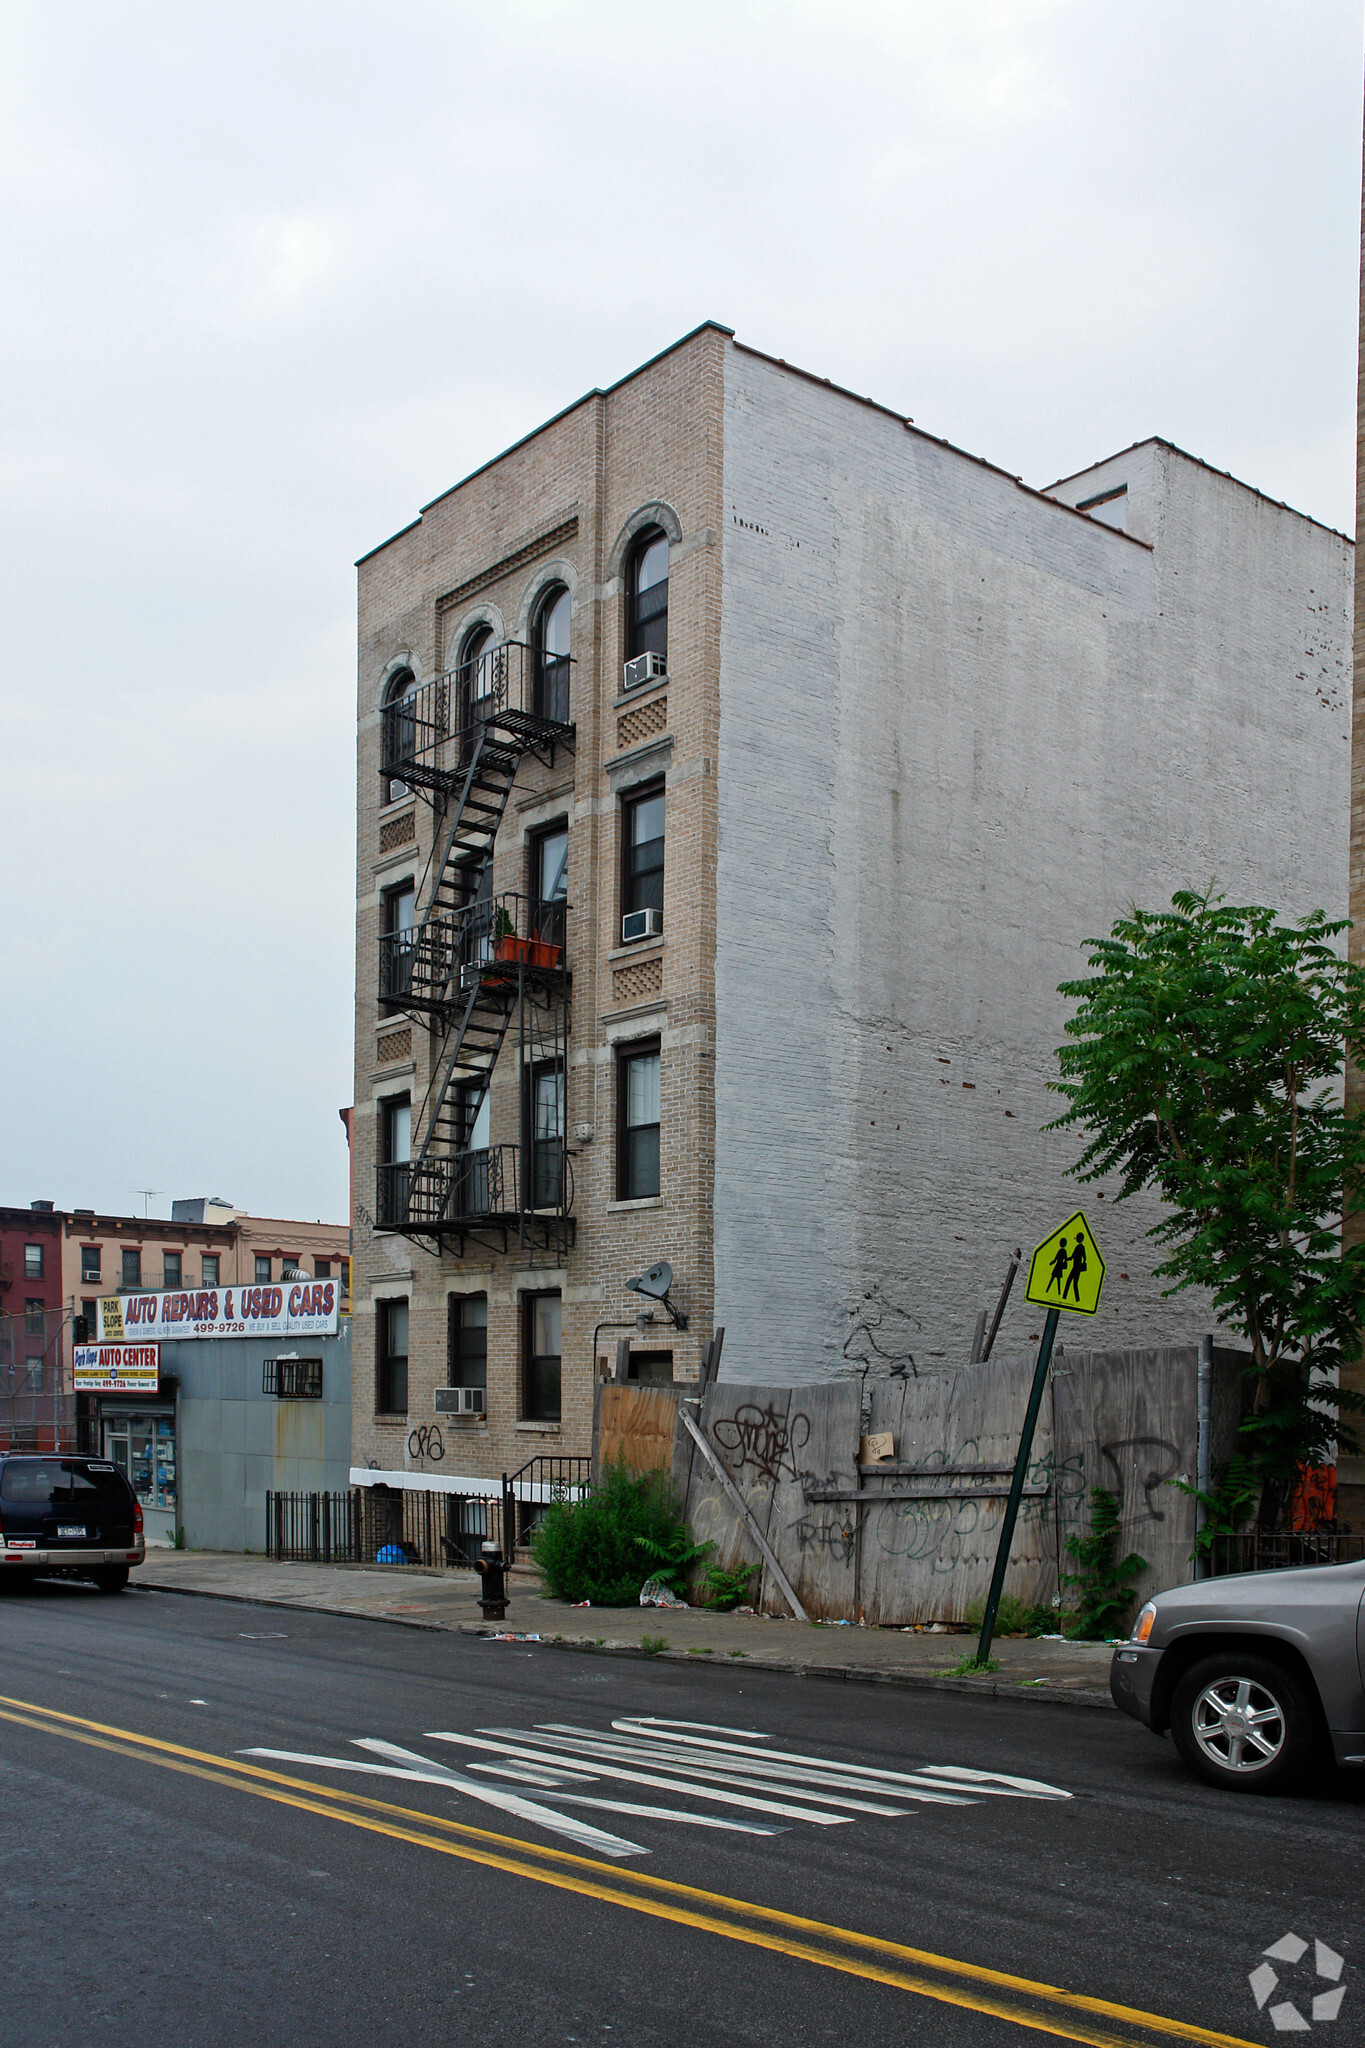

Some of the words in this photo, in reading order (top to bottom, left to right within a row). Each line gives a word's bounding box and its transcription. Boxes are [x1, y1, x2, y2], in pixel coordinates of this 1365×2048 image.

[103, 1300, 118, 1313] PARK
[125, 1295, 157, 1325] AUTO
[161, 1290, 218, 1323] REPAIRS
[224, 1289, 234, 1320] &
[241, 1287, 283, 1319] USED
[288, 1282, 334, 1317] CARS
[103, 1315, 121, 1328] SLOPE
[193, 1322, 245, 1333] 499-9726
[256, 1322, 265, 1331] BUY
[271, 1322, 281, 1331] SELL
[282, 1321, 301, 1331] QUALITY
[302, 1320, 314, 1329] USED
[315, 1320, 328, 1329] CARS
[99, 1348, 121, 1366] AUTO
[123, 1348, 156, 1366] CENTER
[102, 1379, 126, 1388] 499-9726
